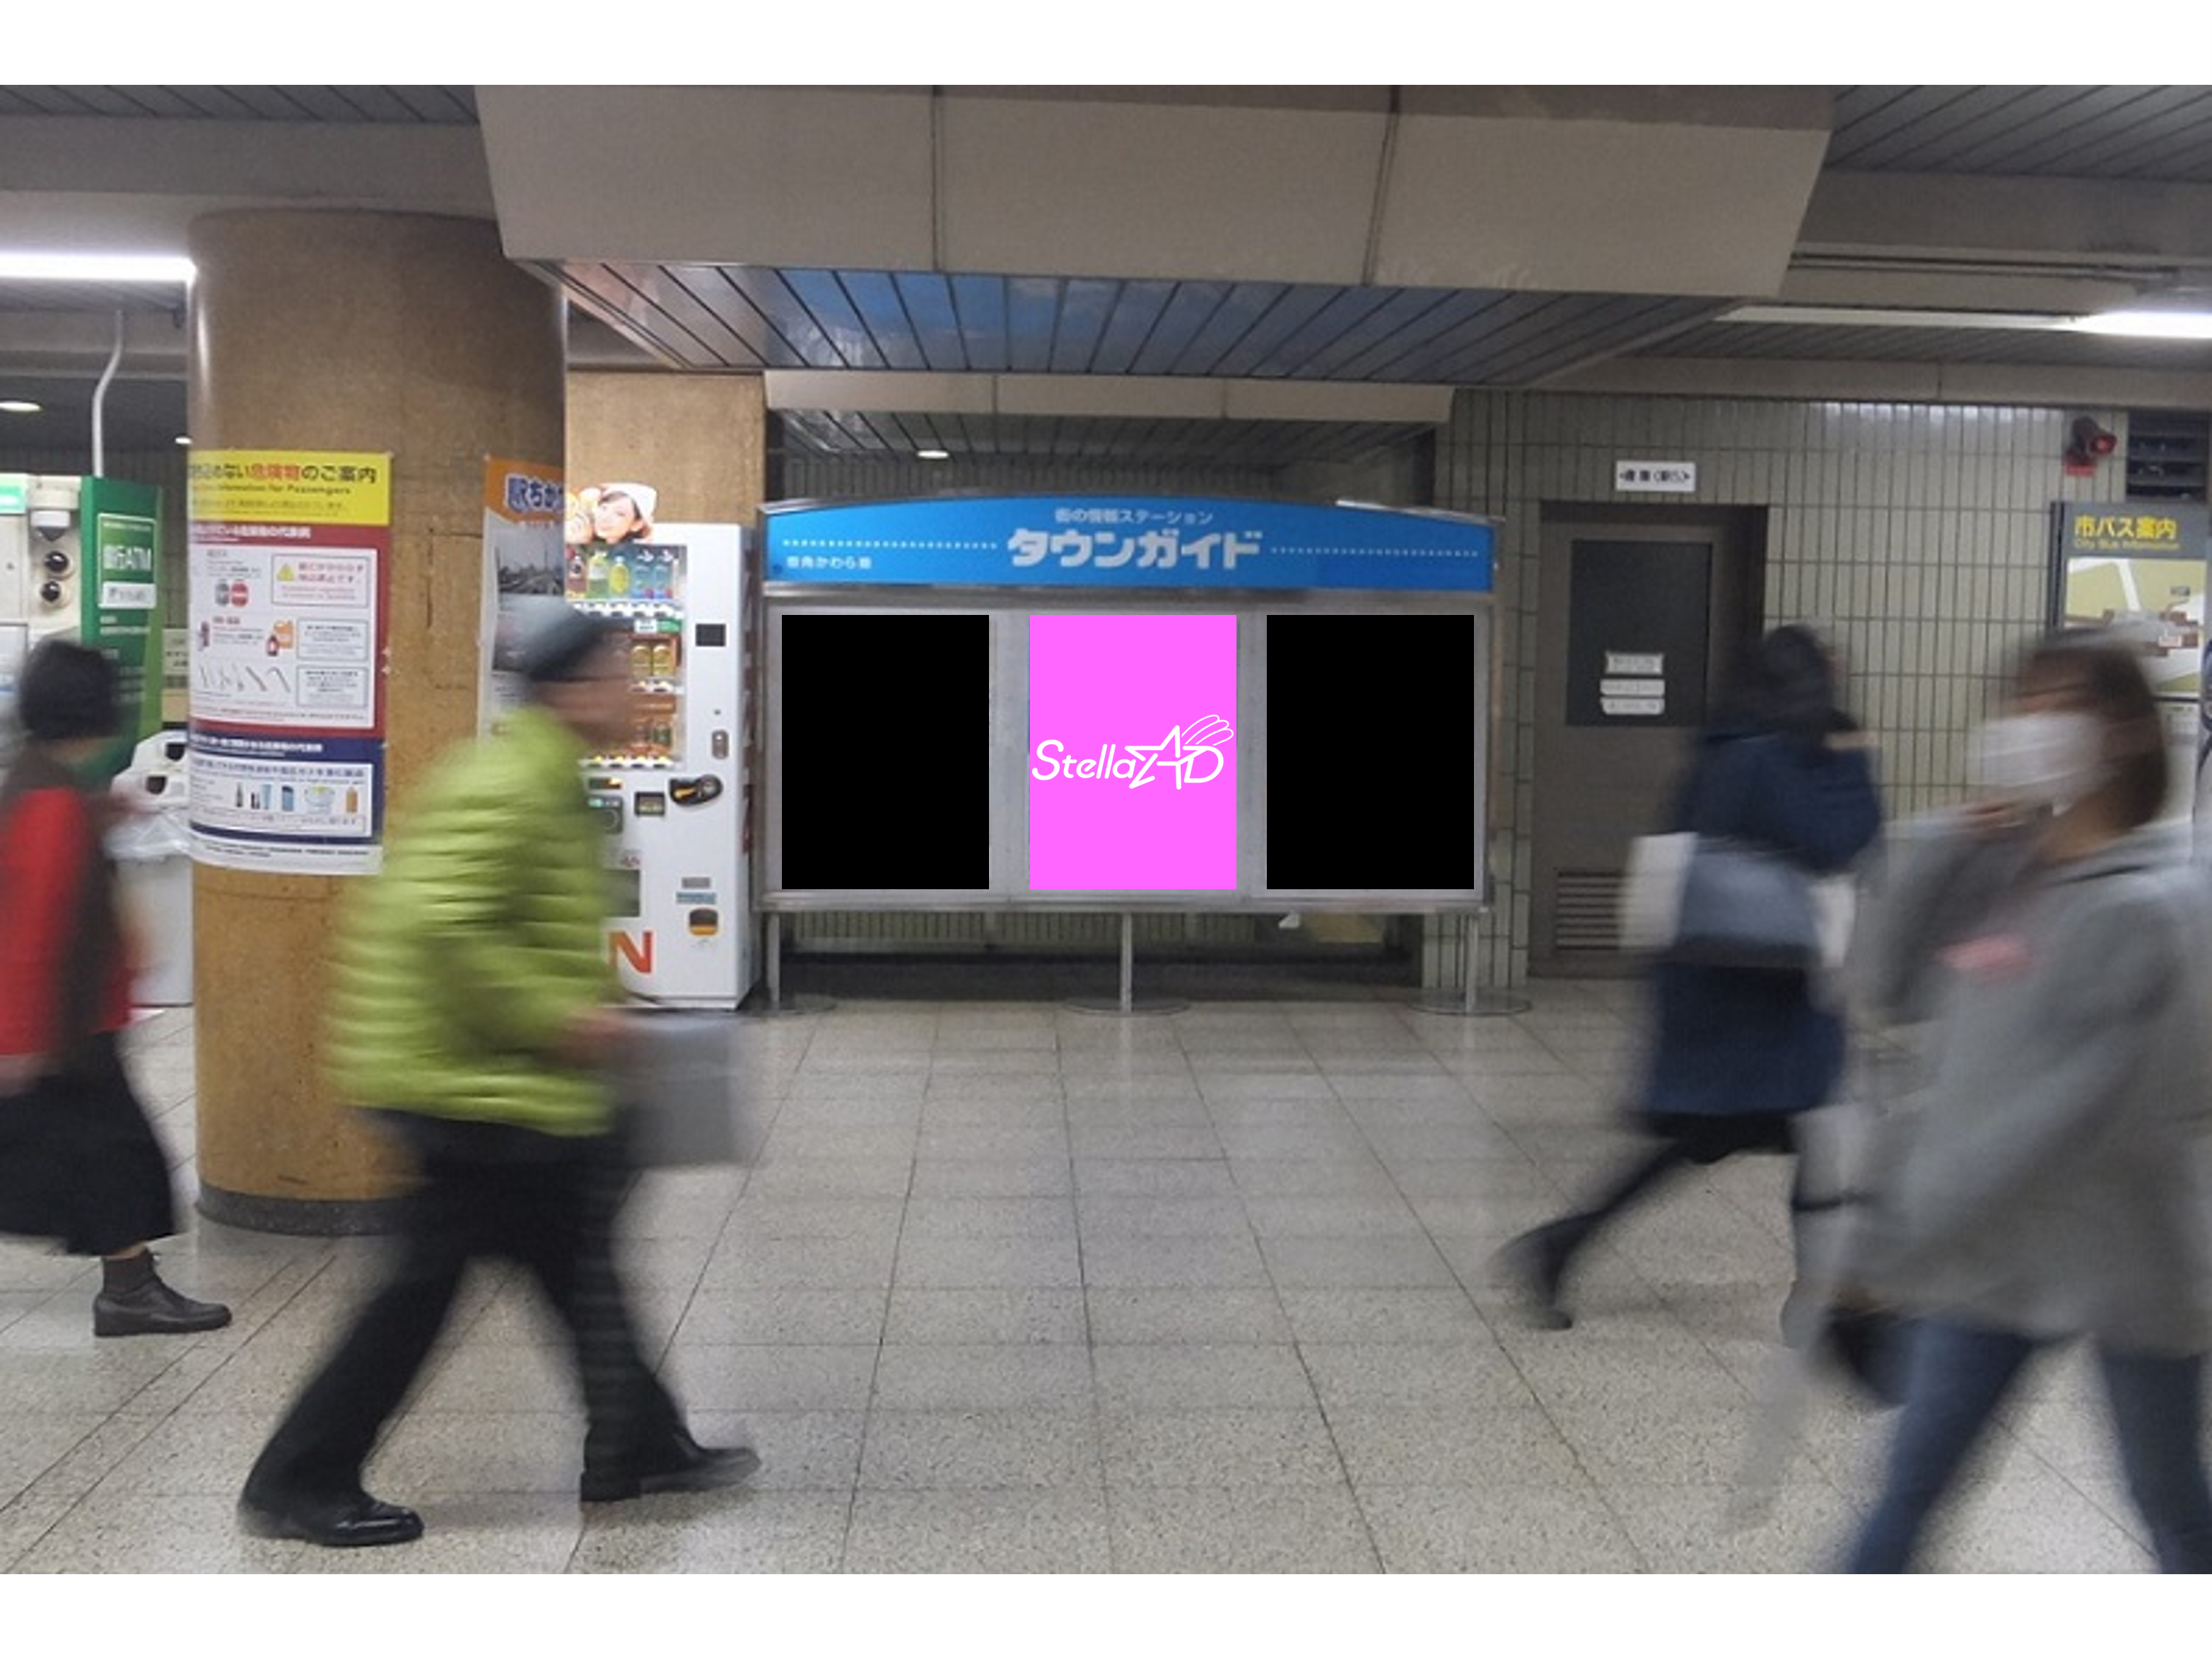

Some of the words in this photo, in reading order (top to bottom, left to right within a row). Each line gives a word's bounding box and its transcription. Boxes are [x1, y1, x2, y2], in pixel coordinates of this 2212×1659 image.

[2075, 515, 2177, 539] 市バス案内
[1007, 527, 1263, 570] タウンガイド
